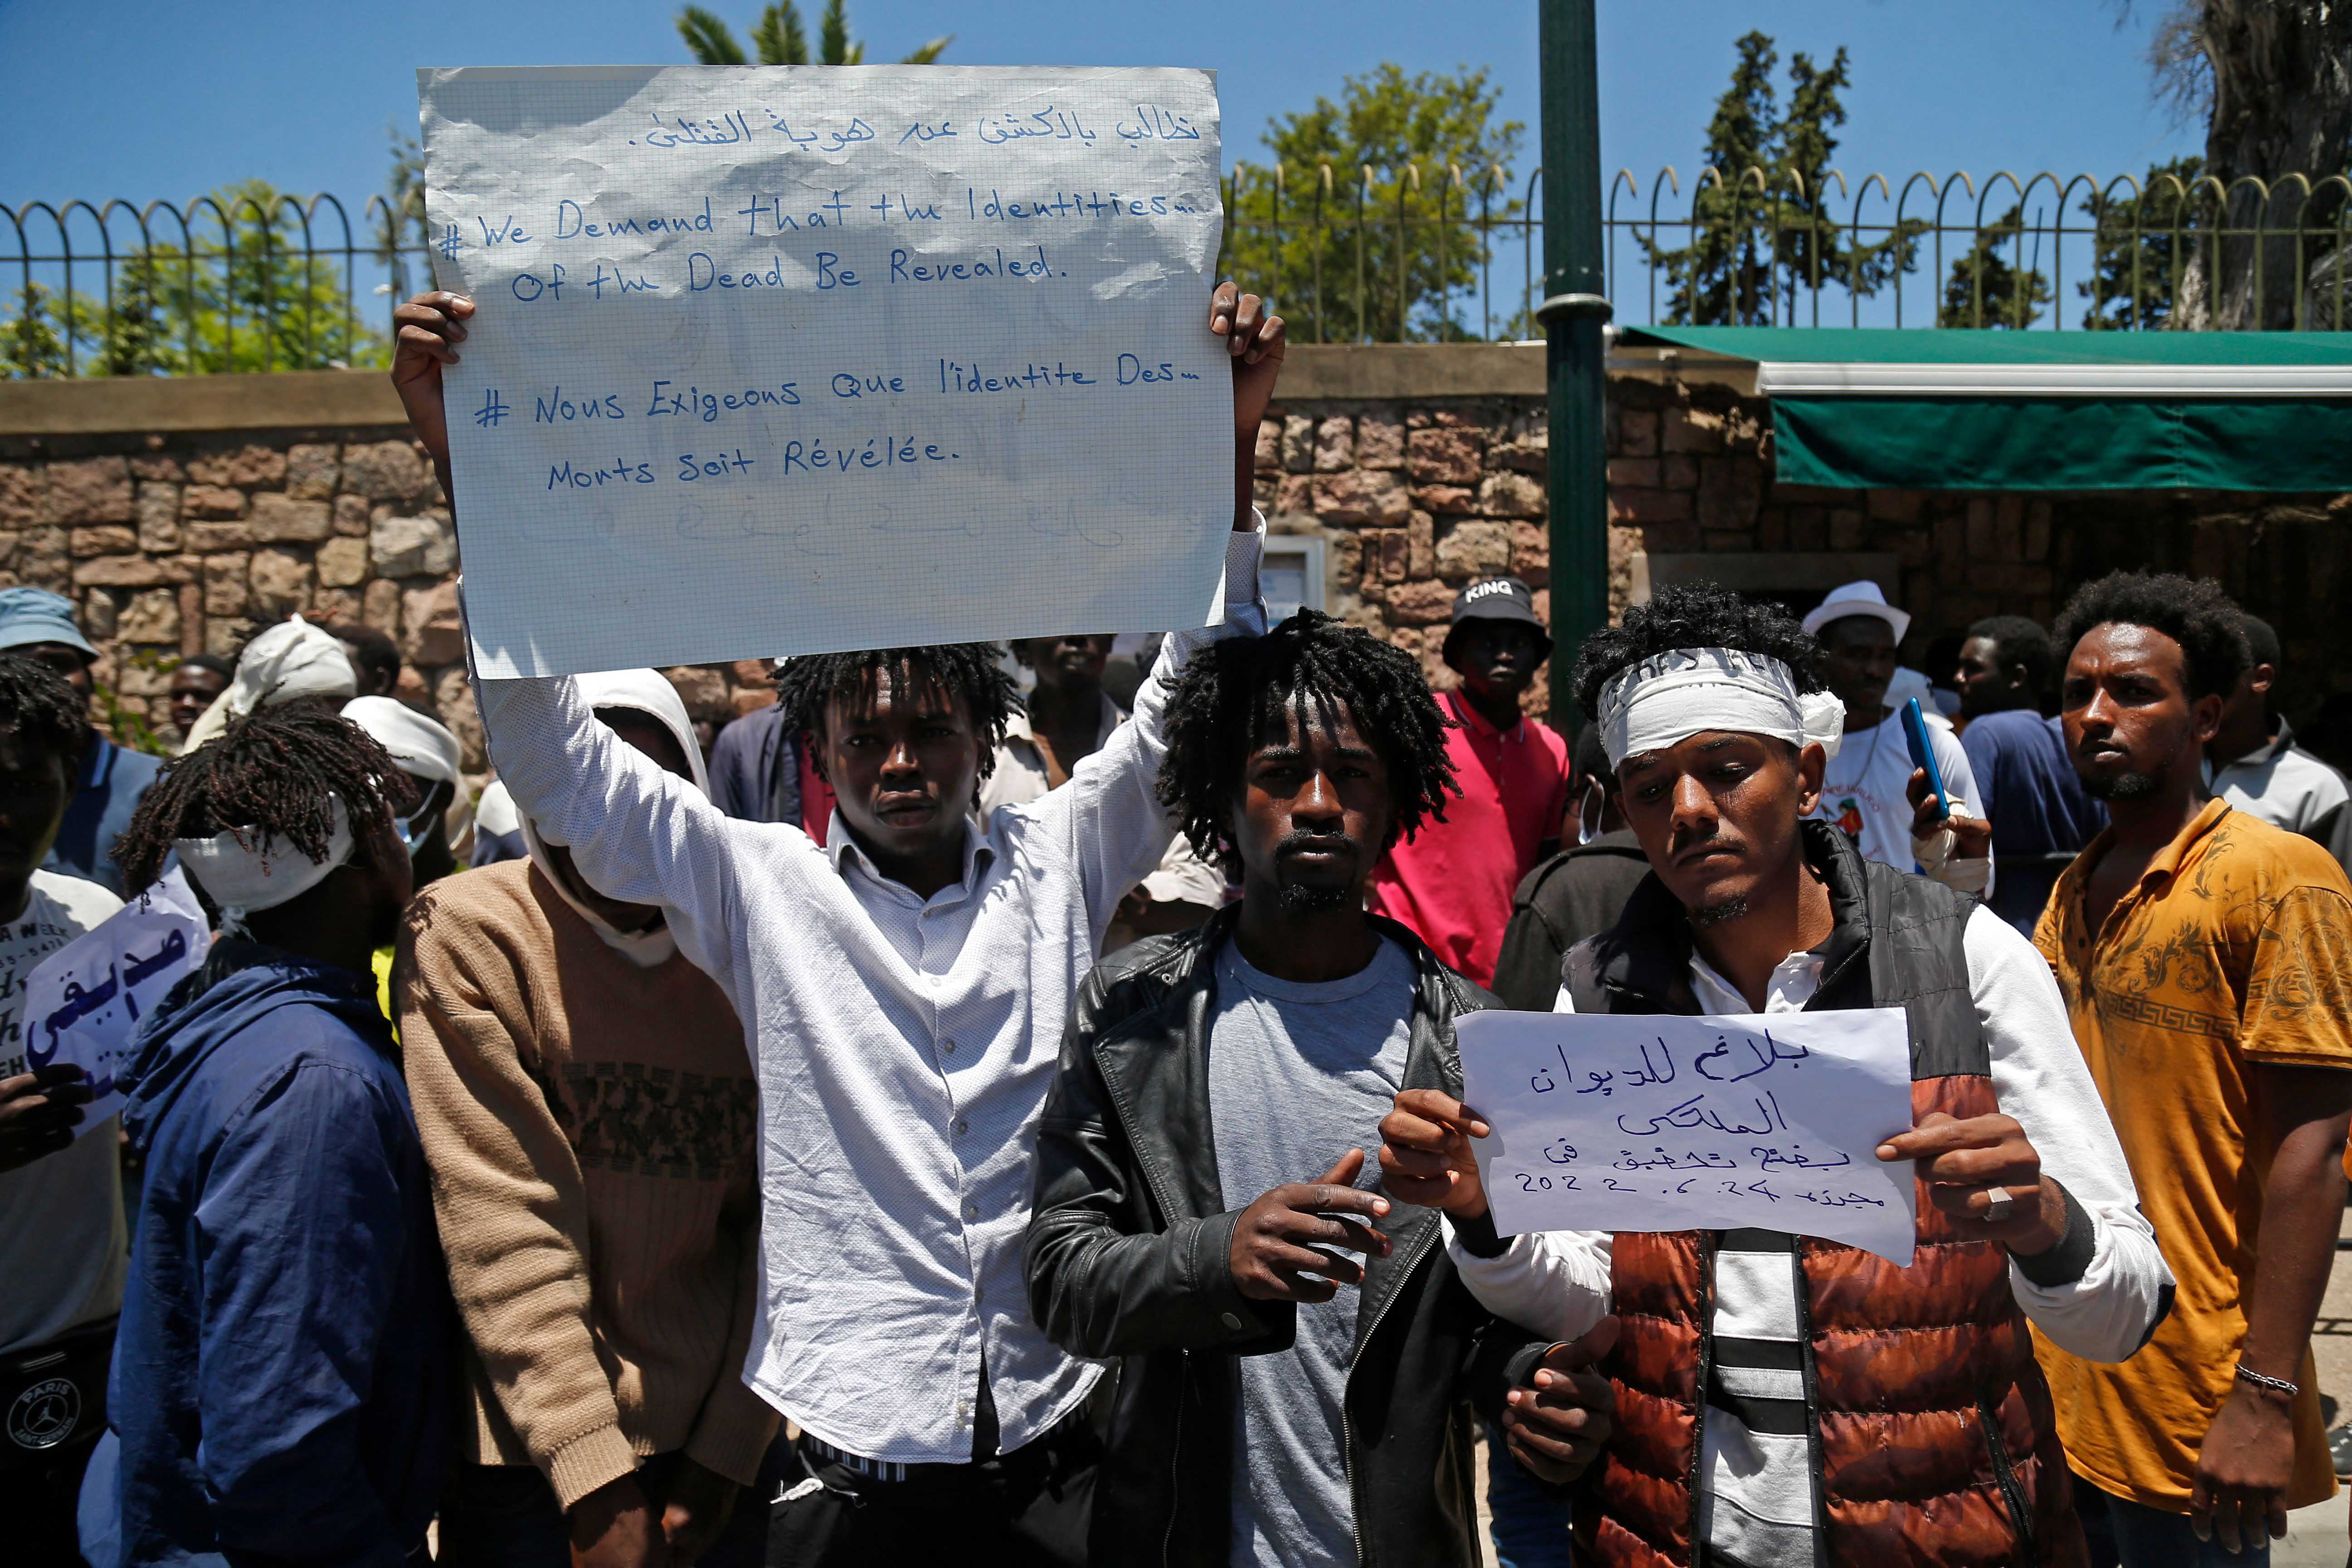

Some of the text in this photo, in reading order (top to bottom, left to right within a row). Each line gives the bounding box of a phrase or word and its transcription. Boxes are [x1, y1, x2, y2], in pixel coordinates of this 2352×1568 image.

[478, 216, 533, 247] We
[556, 199, 713, 240] Demand
[738, 191, 851, 235] that
[689, 253, 784, 291] Dead
[816, 253, 861, 289] Be
[891, 246, 1066, 284] Revealed.
[475, 389, 510, 427] #
[536, 386, 624, 423] Nous
[647, 381, 800, 422] Exigeons
[832, 373, 906, 398] Que
[679, 449, 755, 481] Soit
[785, 436, 959, 475] Révélée.
[1465, 581, 1513, 603] KING
[21, 1382, 70, 1403] PARIS
